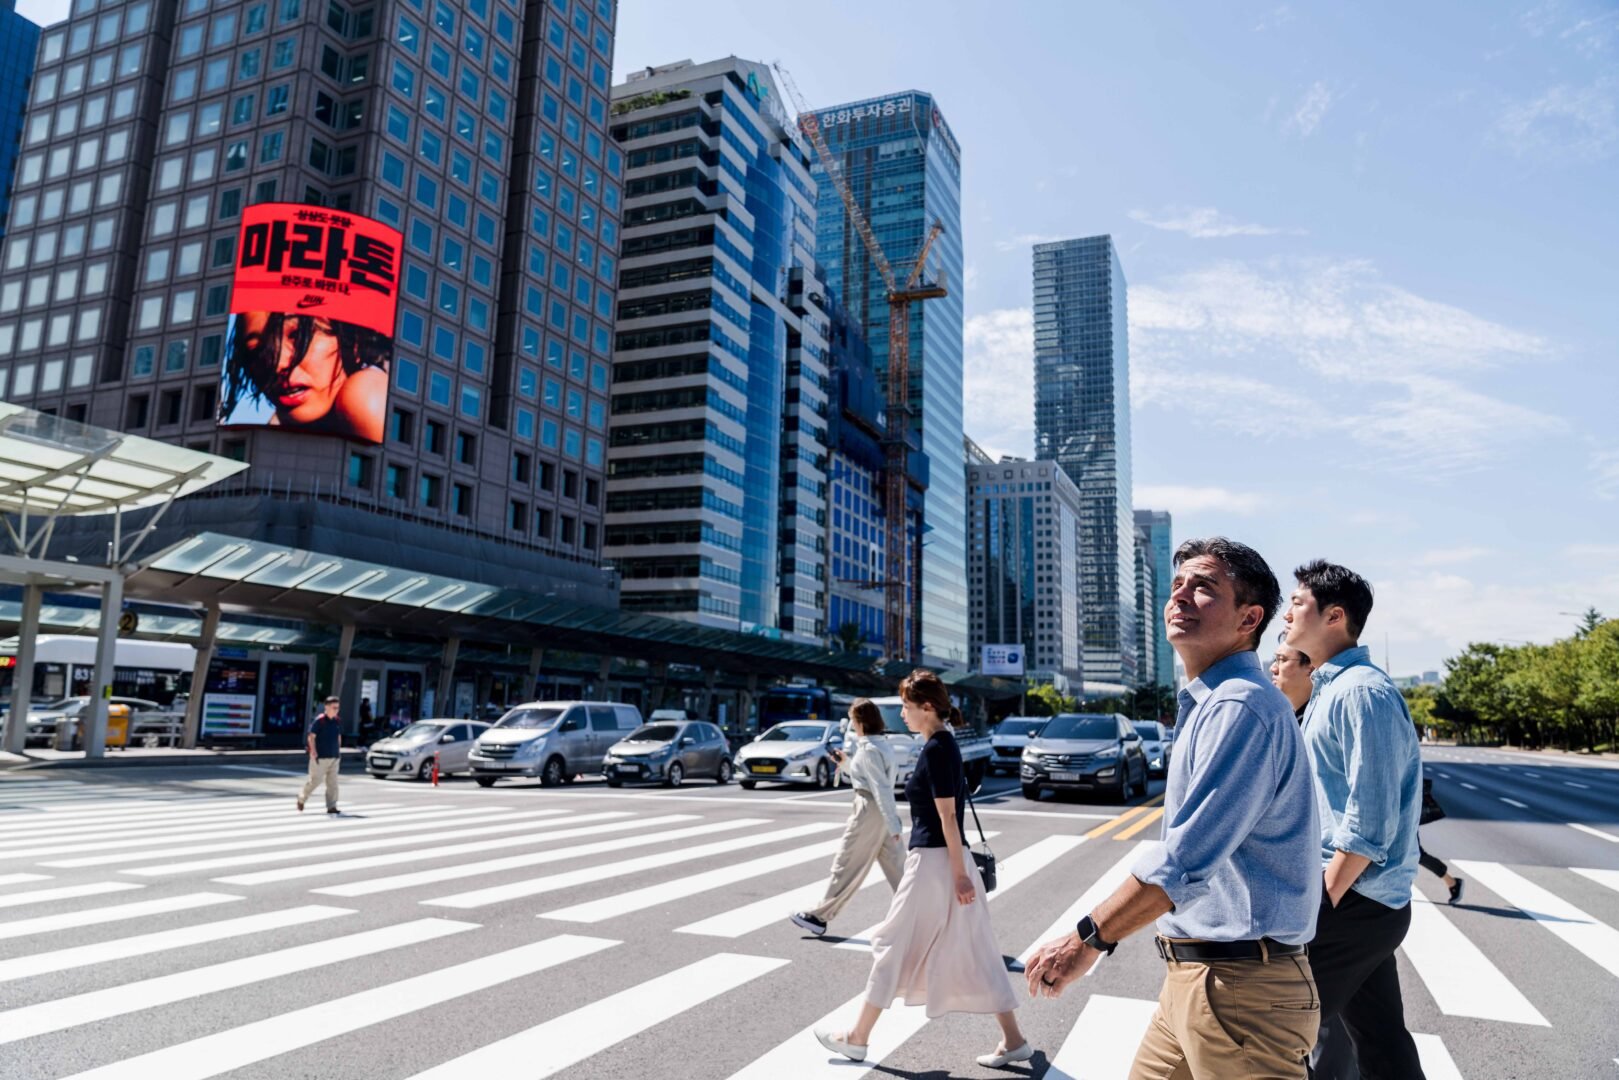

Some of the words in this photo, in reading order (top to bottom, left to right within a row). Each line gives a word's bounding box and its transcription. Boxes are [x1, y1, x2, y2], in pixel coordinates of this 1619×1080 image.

[822, 97, 911, 128] 한화투자증권
[240, 220, 395, 296] 마라톤
[281, 274, 312, 288] 완주로
[315, 278, 337, 293] 바뀐
[121, 613, 132, 631] 2
